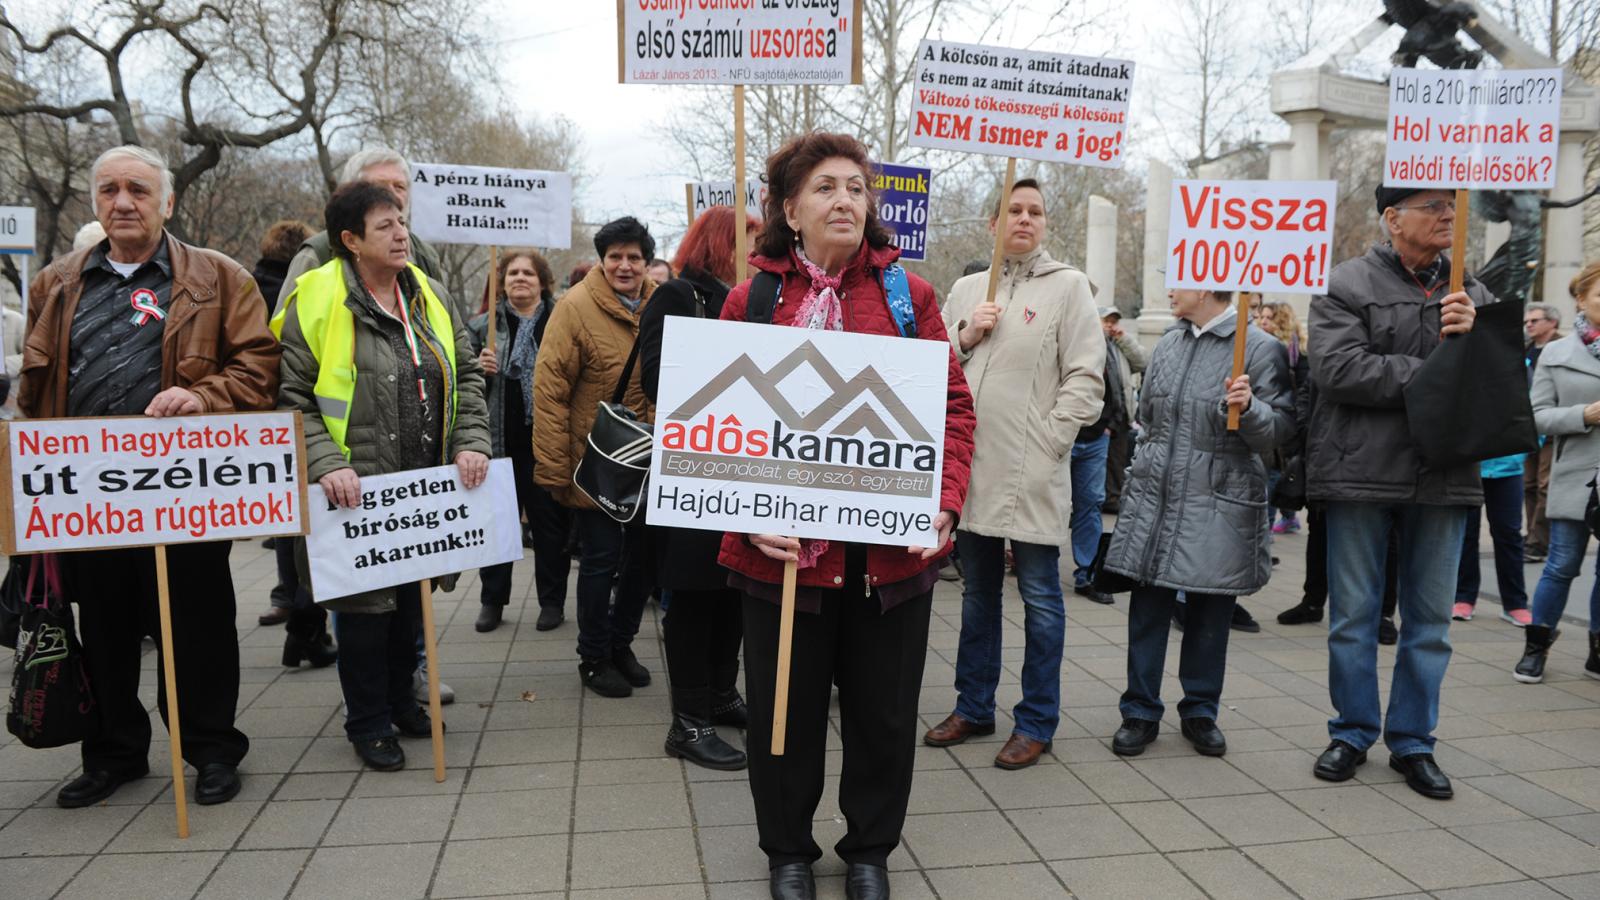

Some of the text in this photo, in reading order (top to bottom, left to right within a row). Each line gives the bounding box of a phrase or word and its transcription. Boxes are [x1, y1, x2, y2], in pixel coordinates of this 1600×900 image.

[637, 17, 847, 59] első számú uzsorása"
[633, 68, 659, 80] Lázár
[662, 68, 690, 81] János
[729, 66, 751, 80] NFÜ
[753, 68, 843, 82] sajtótájékoztatóján
[923, 45, 1129, 80] A kölcsön az, amit átadnak
[921, 68, 1129, 102] és nem az amit átszámítanak!
[1396, 76, 1419, 104] Hol
[1423, 84, 1431, 104] a
[1436, 79, 1464, 105] 210
[1469, 77, 1556, 105] milliárd???
[919, 89, 1124, 124] Változó tőkeösszegű kölcsönt
[915, 111, 1123, 161] NEM ismer a jog!
[1393, 115, 1553, 144] Hol vannak a
[414, 169, 546, 191] A pénz hiánya
[870, 173, 928, 193] arunk
[1389, 155, 1552, 182] valódi felelősök?
[446, 193, 506, 209] aBank
[696, 185, 706, 209] A
[875, 196, 926, 225] orló
[1180, 185, 1327, 232] Vissza
[1172, 239, 1327, 288] 100%-ot!
[18, 423, 290, 458] Nem hagytatok az
[22, 453, 294, 497] út szélén!
[666, 455, 930, 492] Egy gondolat, egy szó, egy tett!
[25, 497, 144, 539] Árokba
[155, 491, 293, 537] rúgtatok!
[656, 485, 932, 537] Hajdú-Bihar megye
[354, 528, 485, 569] akarunk!!!
